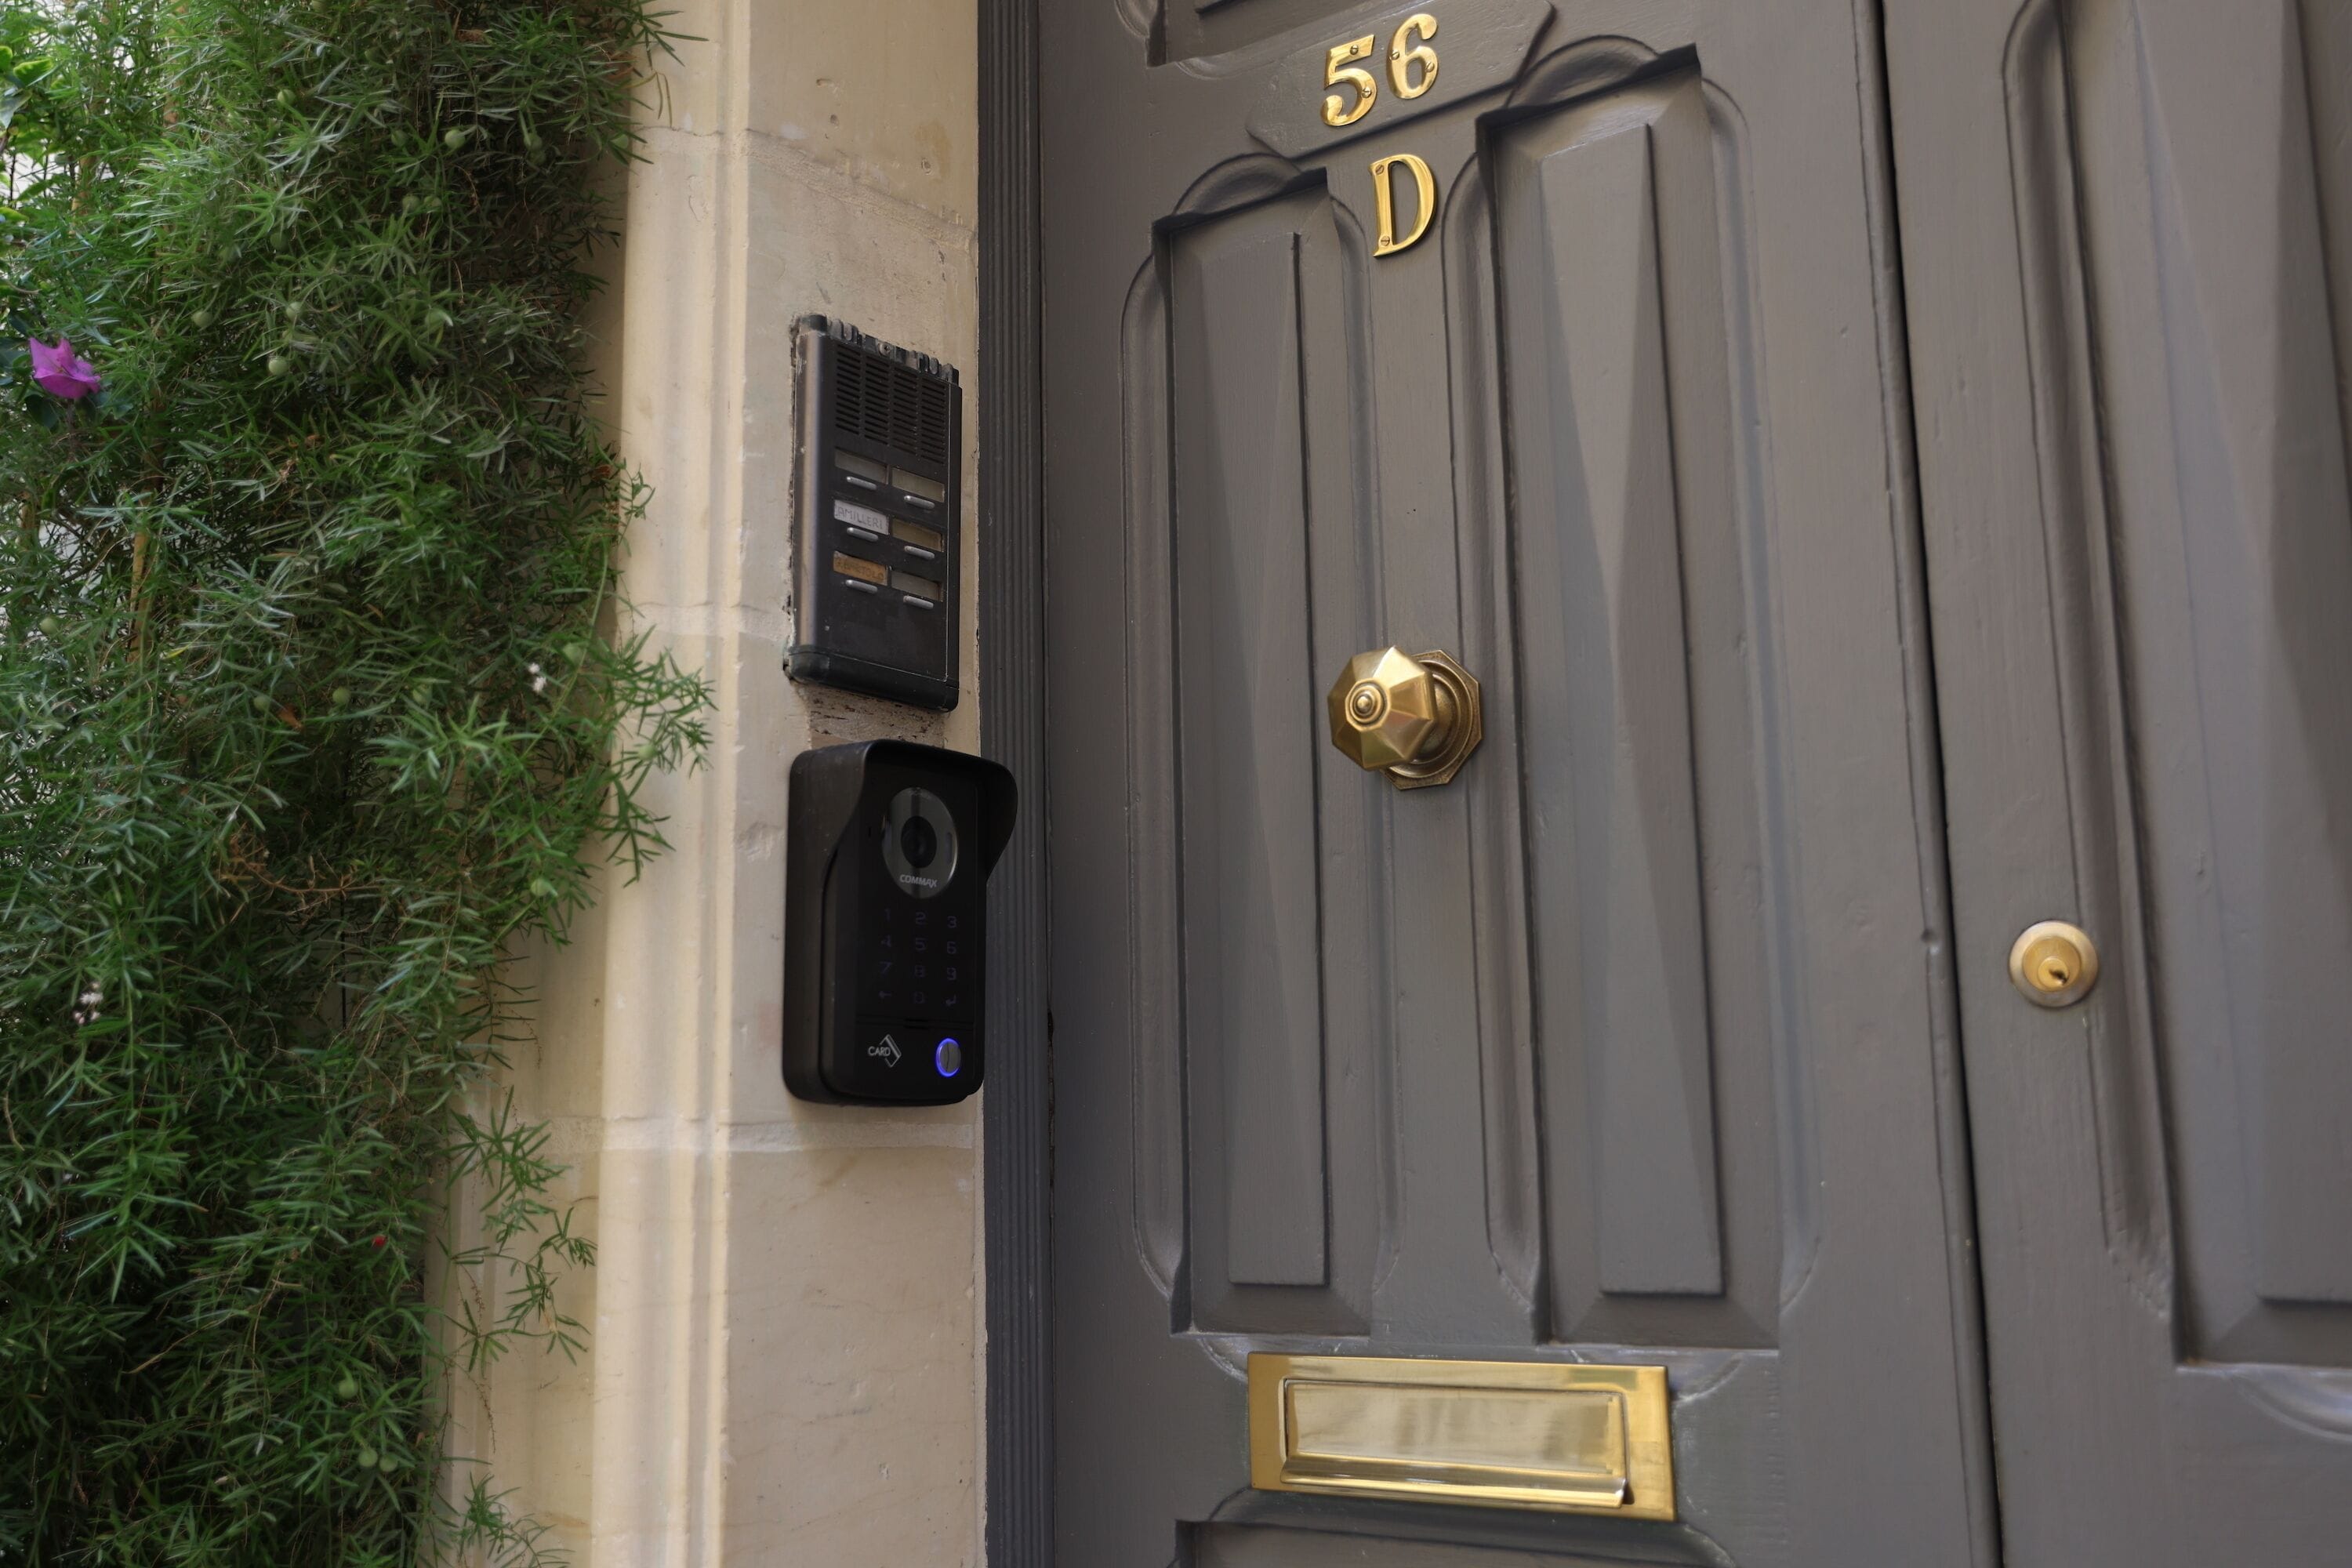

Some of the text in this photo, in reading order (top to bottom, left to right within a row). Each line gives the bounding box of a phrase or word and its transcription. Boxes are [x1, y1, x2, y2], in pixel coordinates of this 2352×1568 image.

[1320, 13, 1438, 126] 56
[1370, 154, 1438, 257] D
[834, 506, 883, 530] AMILLERI
[899, 874, 938, 888] COMMAX
[915, 911, 926, 925] 2
[947, 915, 956, 928] 3
[880, 935, 956, 954] 4 5 6
[880, 960, 956, 981] 7 8 9
[868, 1045, 891, 1057] CARD
